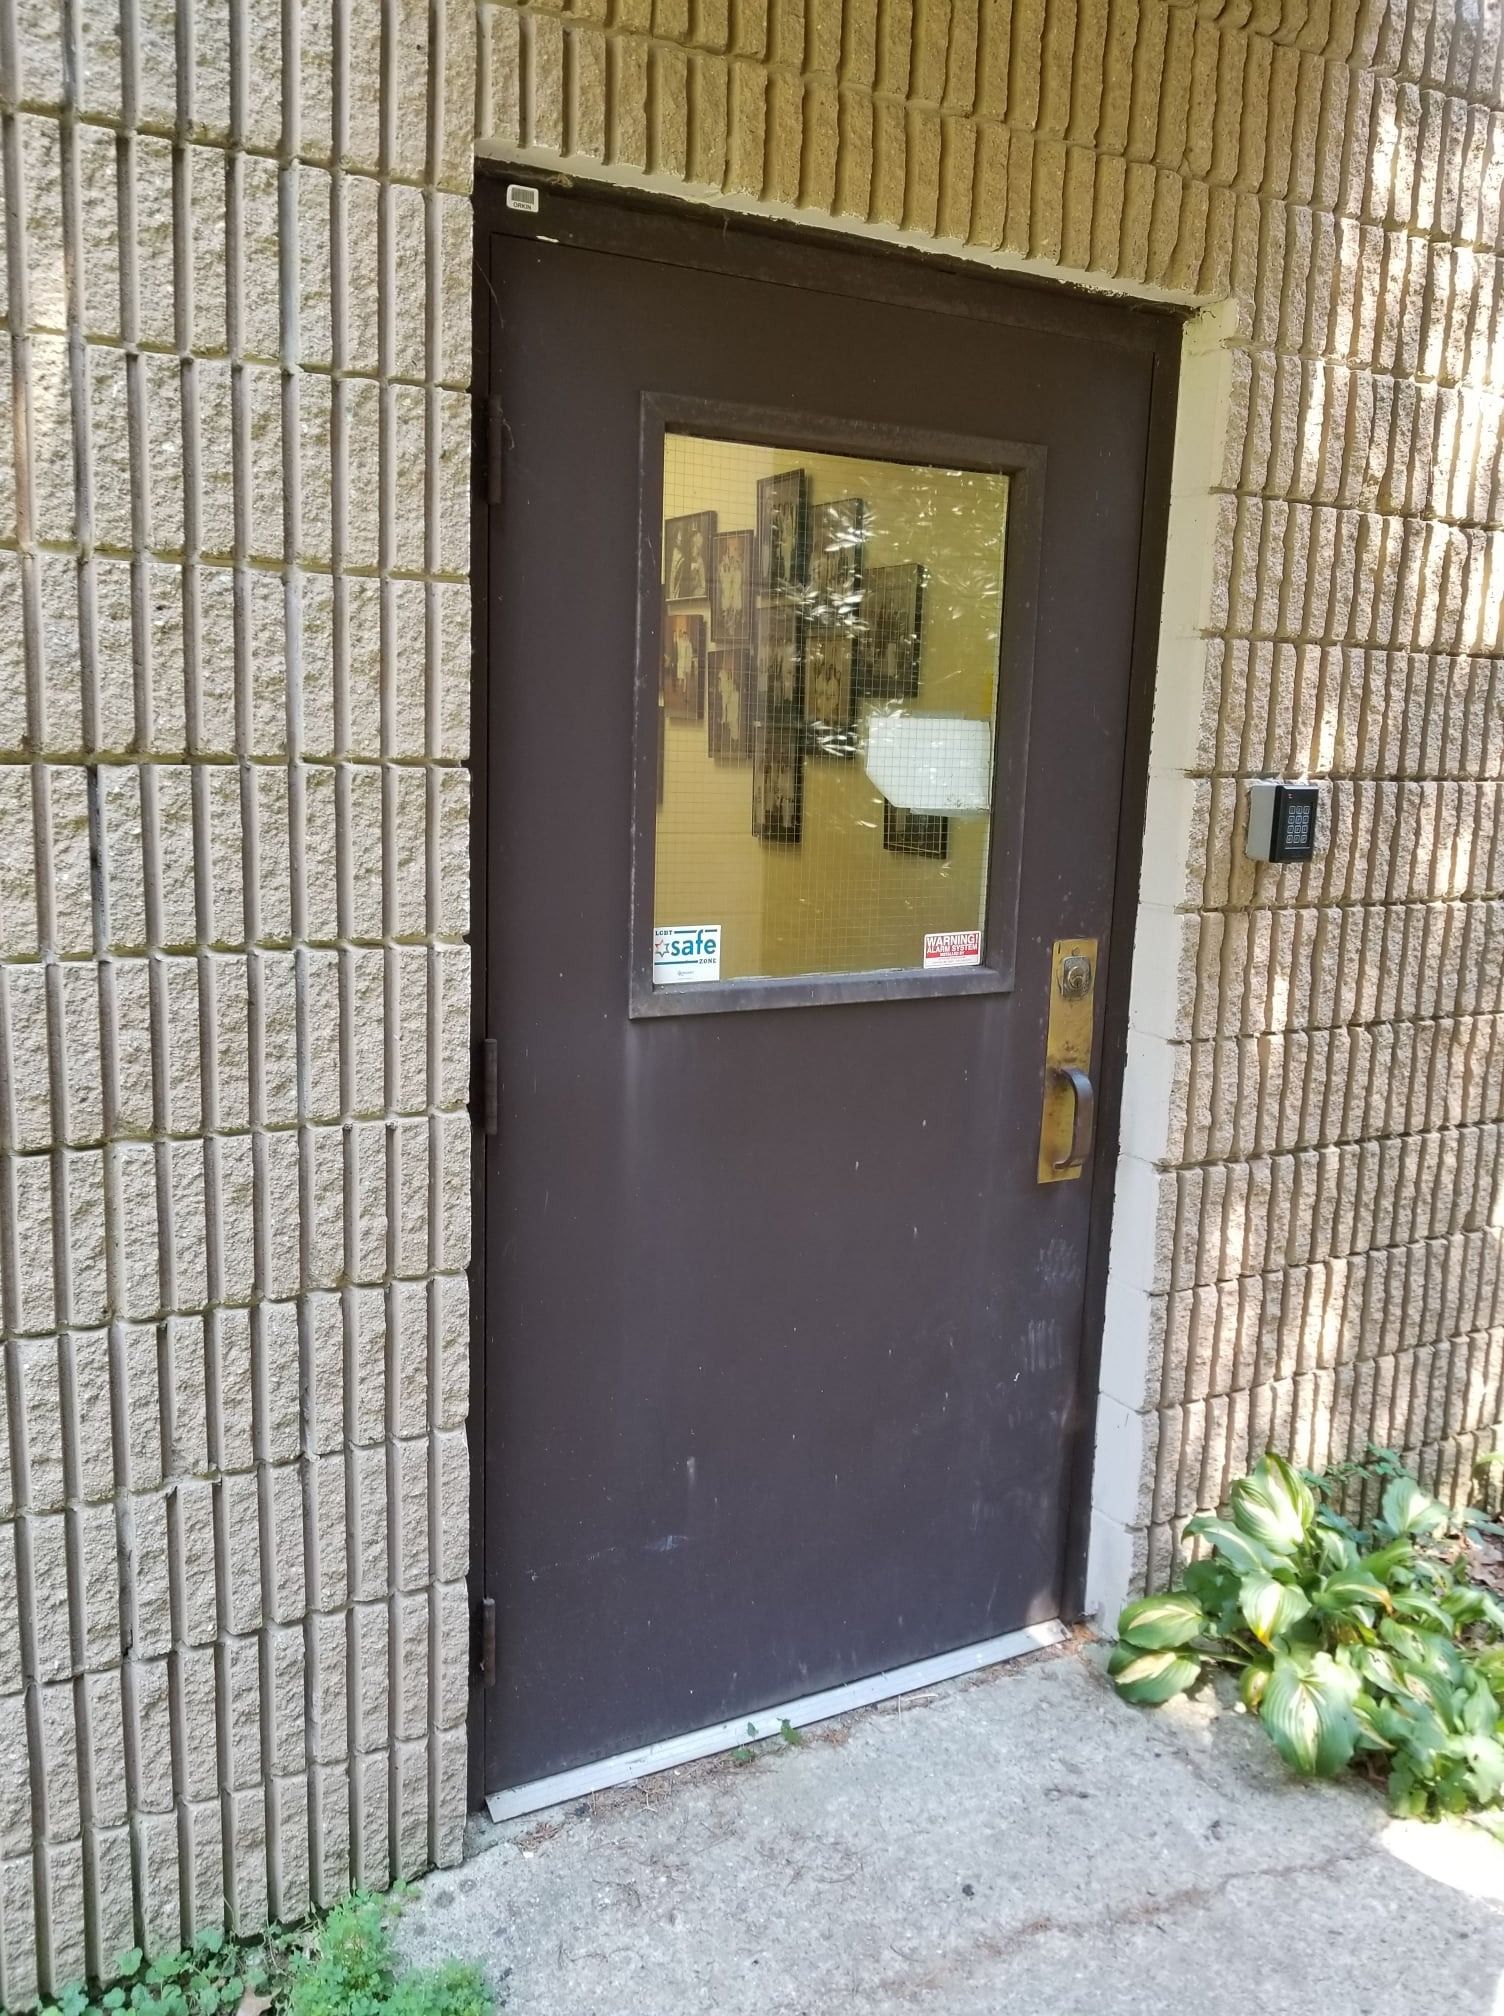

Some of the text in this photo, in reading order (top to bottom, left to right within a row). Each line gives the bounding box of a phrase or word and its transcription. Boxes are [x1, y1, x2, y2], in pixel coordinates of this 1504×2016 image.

[671, 929, 716, 956] safe
[927, 934, 977, 946] WARNING!
[927, 945, 950, 953] ALARM
